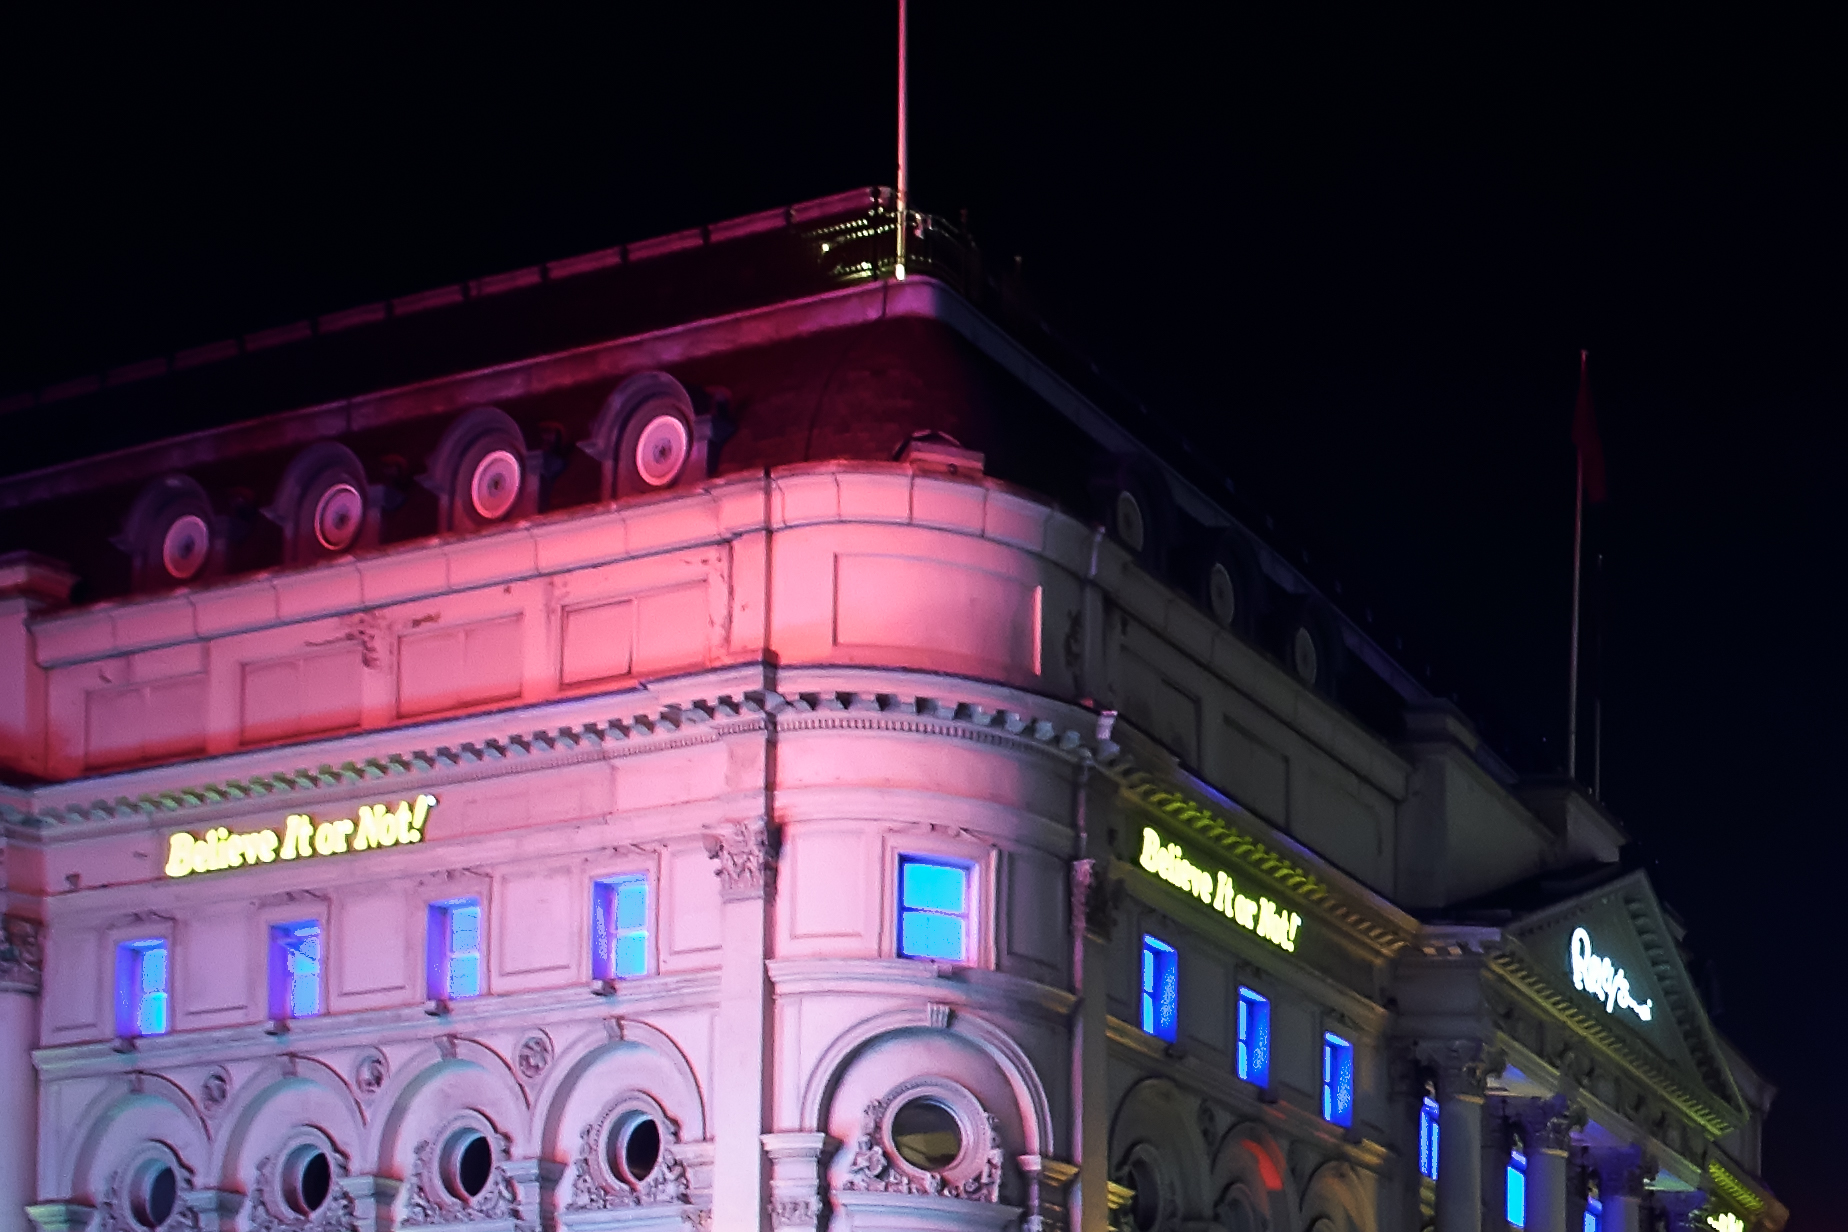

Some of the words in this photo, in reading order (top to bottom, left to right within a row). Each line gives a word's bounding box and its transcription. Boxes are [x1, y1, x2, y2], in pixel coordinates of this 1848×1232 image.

[165, 827, 279, 877] Believe
[280, 814, 313, 860] It
[315, 819, 354, 856] or
[353, 794, 428, 851] Not!
[1139, 827, 1213, 904] Believe
[1213, 871, 1235, 918] It
[1234, 894, 1258, 930] or
[1256, 897, 1298, 953] Not!
